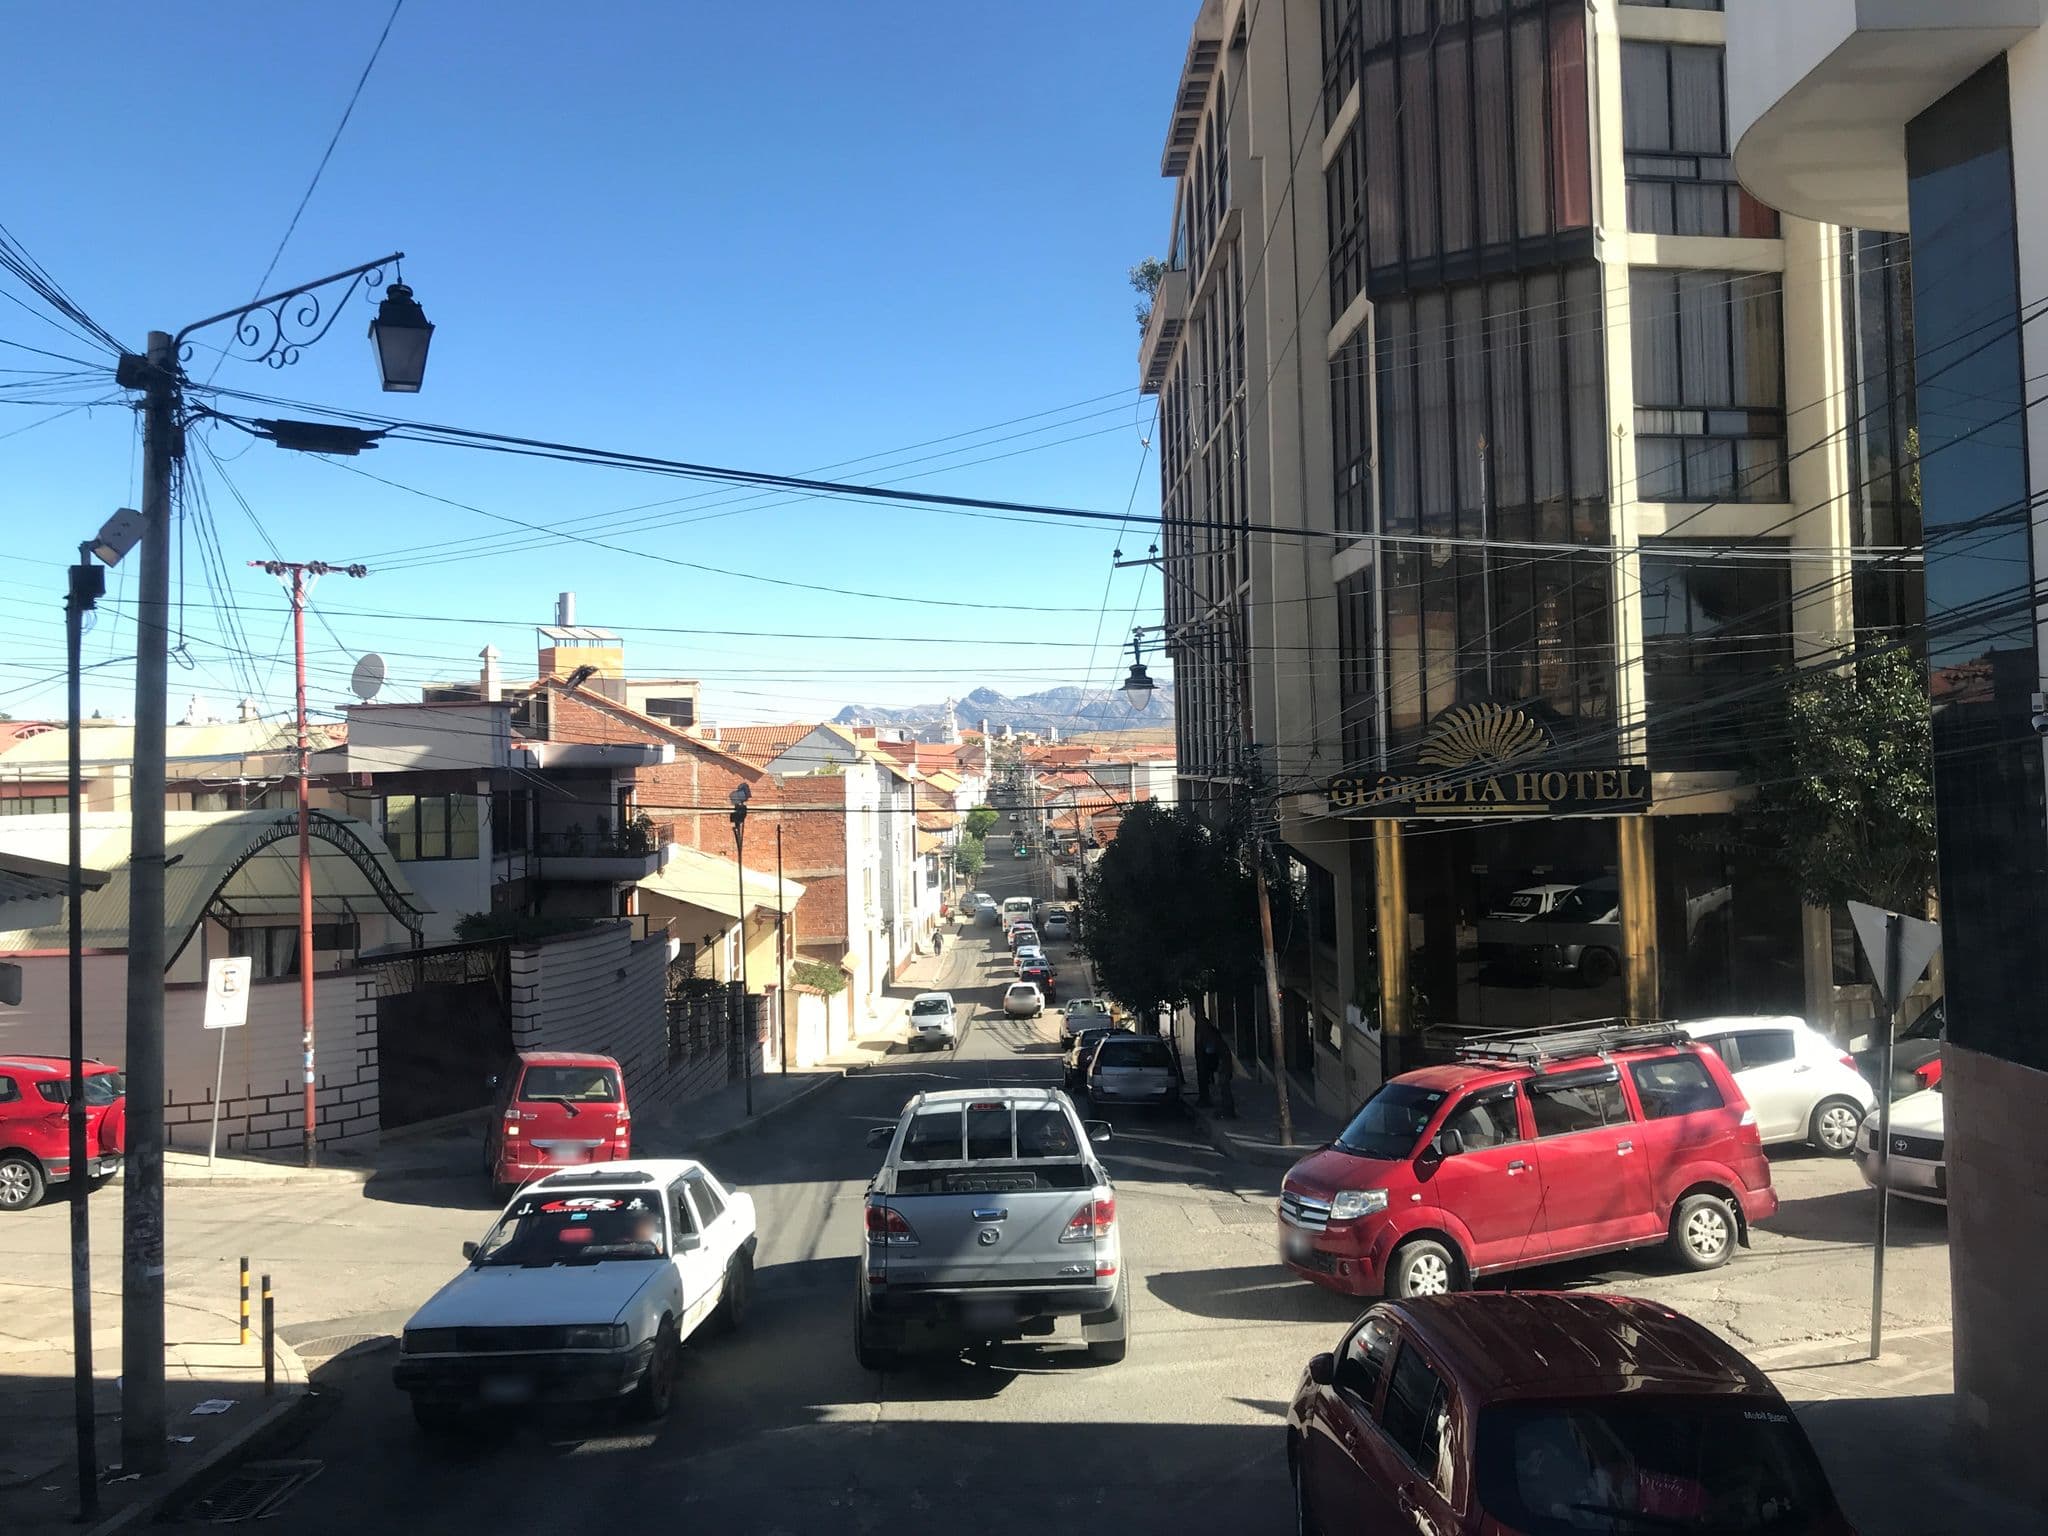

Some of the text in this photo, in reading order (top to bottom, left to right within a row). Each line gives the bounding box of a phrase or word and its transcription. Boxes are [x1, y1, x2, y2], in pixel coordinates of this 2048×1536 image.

[1331, 769, 1645, 807] GLORIETA HOTEL
[223, 970, 237, 992] E
